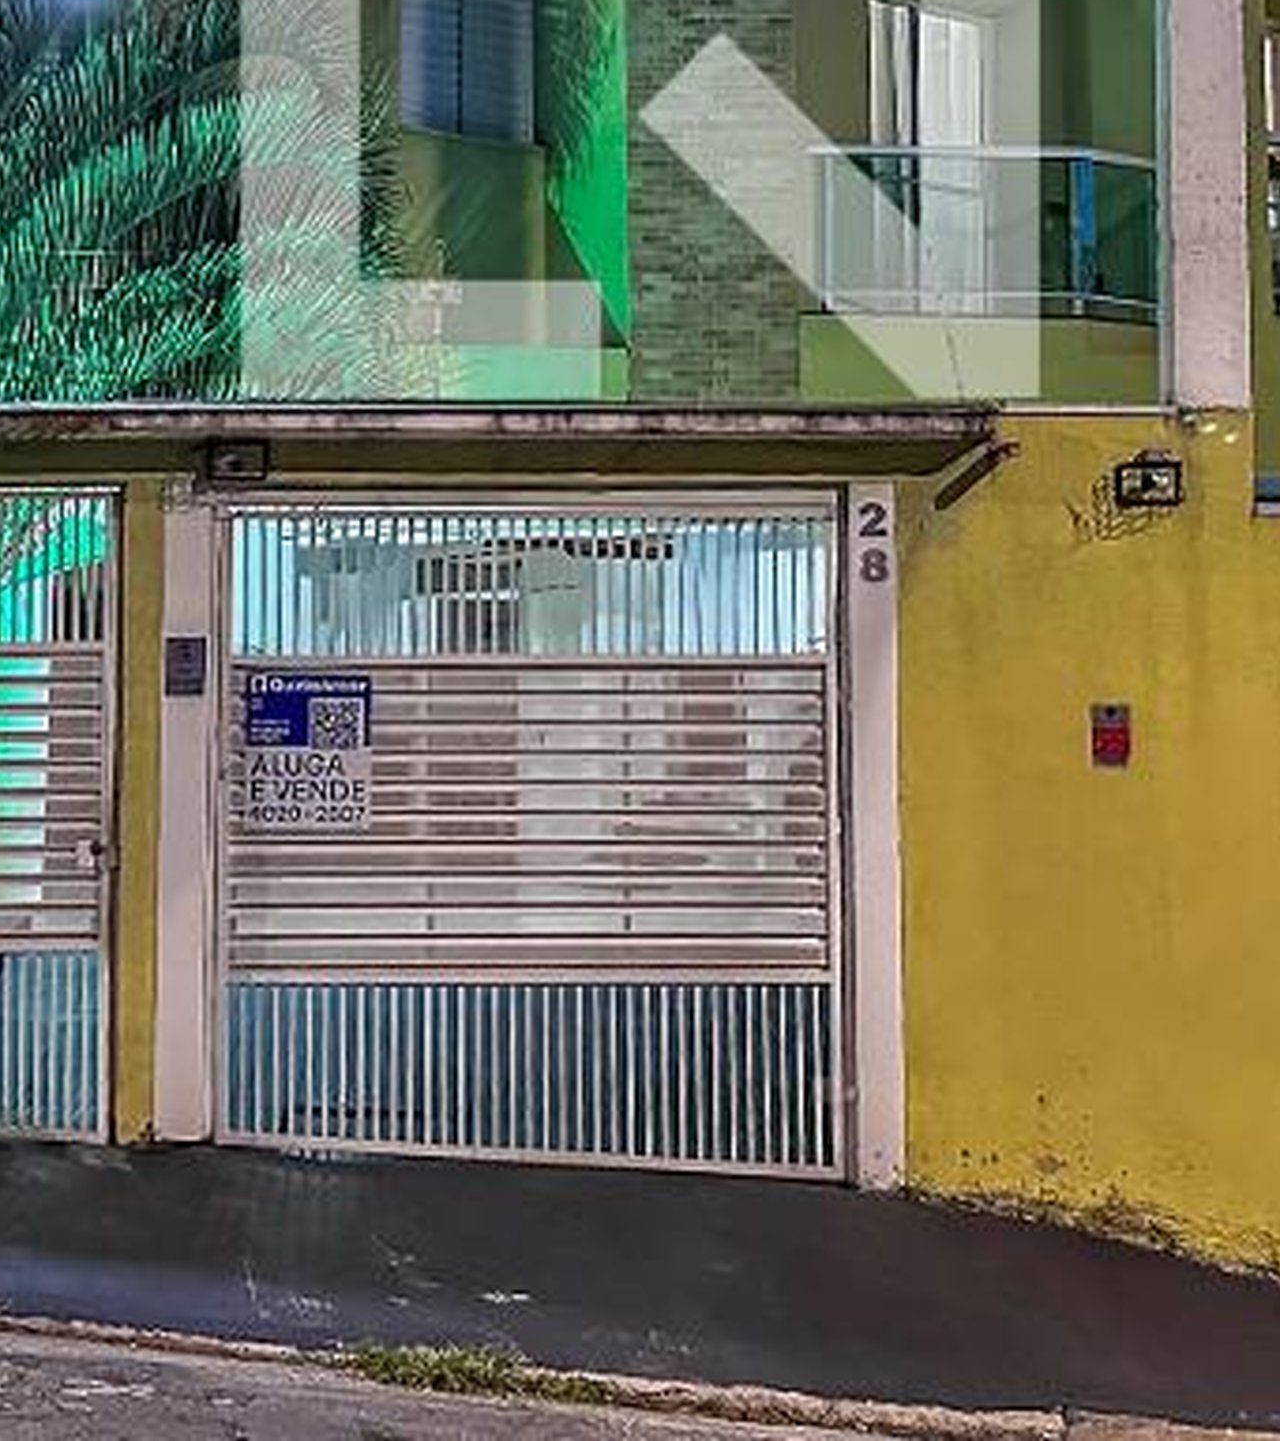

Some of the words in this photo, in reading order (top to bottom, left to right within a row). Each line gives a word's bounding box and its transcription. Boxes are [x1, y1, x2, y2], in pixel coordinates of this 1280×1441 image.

[859, 502, 889, 582] 28
[251, 753, 346, 776] ALUGA
[251, 780, 264, 802] E
[272, 780, 364, 802] VENDE
